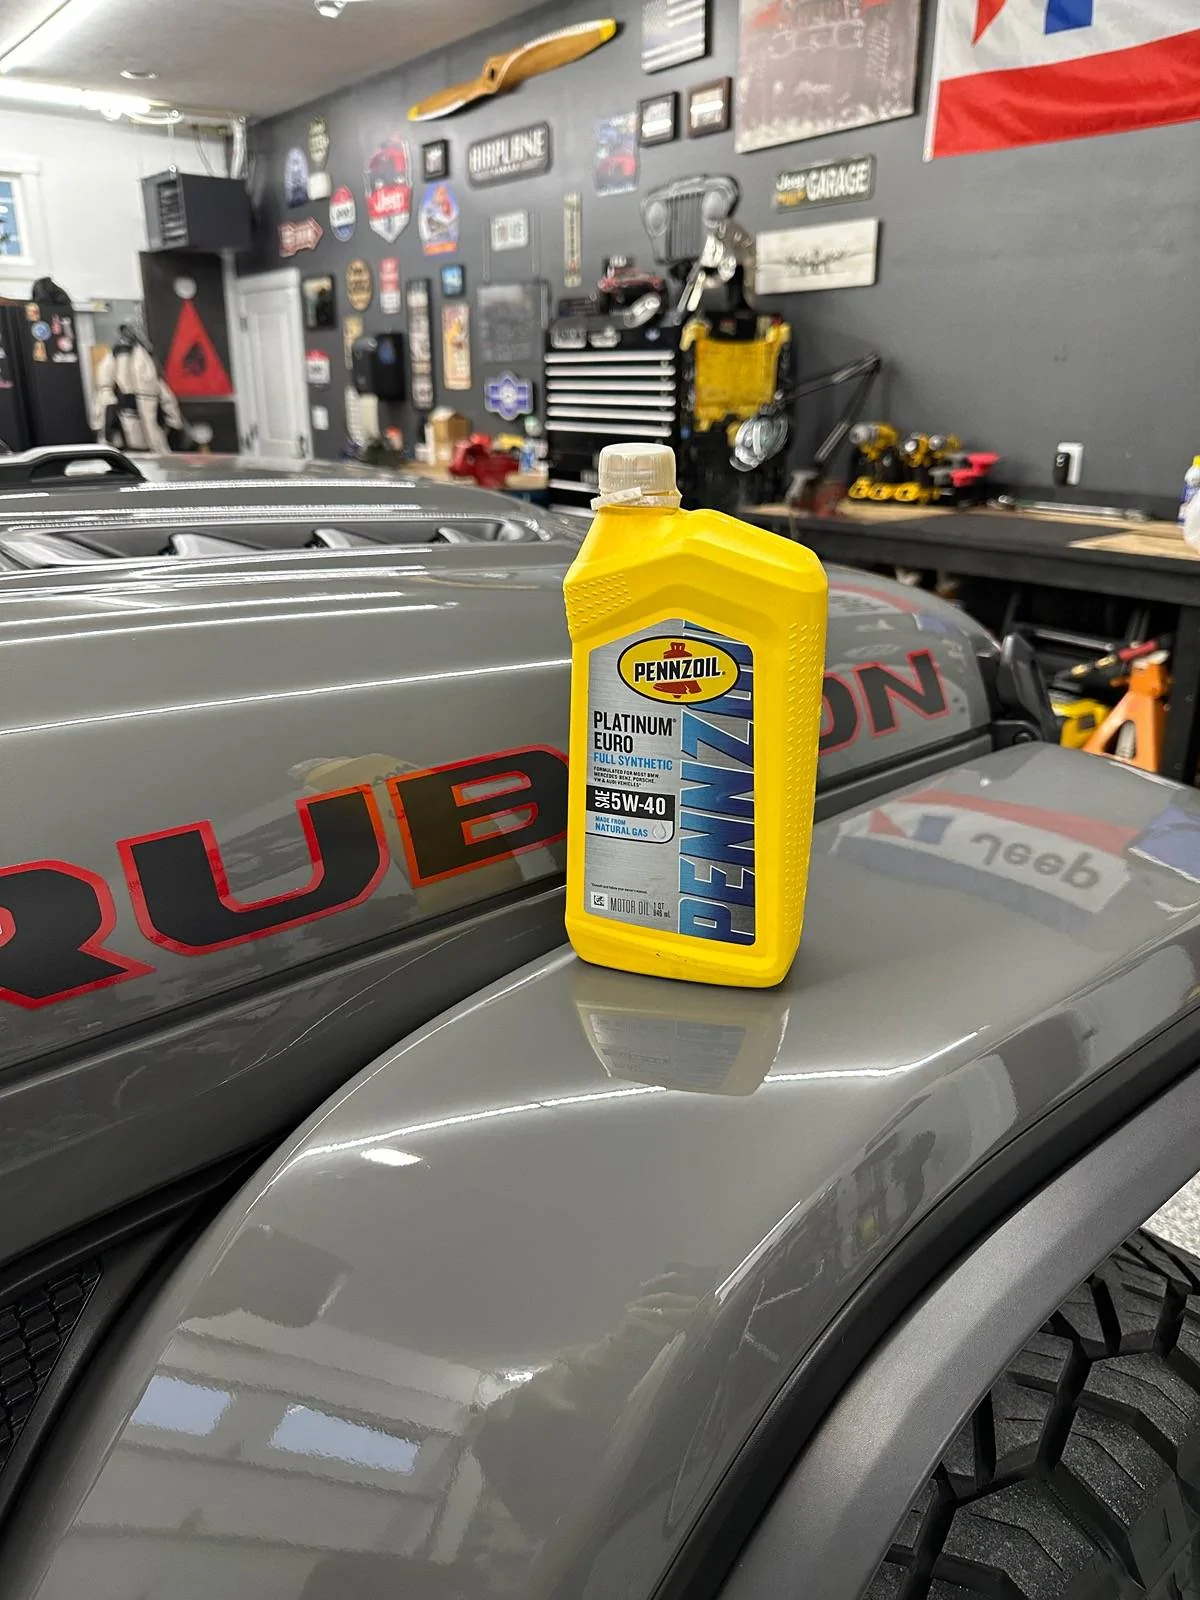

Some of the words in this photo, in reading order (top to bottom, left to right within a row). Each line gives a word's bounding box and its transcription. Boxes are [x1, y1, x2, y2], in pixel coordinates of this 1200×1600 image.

[806, 161, 869, 201] GARAGE
[633, 656, 721, 683] PENNZOIL
[593, 711, 673, 736] PLATINUM
[594, 732, 634, 753] EURO
[593, 752, 616, 765] FULL
[618, 755, 673, 771] SYNTHETIC
[593, 766, 623, 775] FORMULATED
[594, 789, 610, 809] SAE
[611, 792, 666, 816] 5W-40
[595, 815, 610, 823] MADE
[611, 818, 626, 826] FROM
[595, 822, 630, 835] NATURAL
[631, 828, 649, 838] GAS
[610, 897, 636, 914] MOTOR
[638, 900, 652, 916] OIL
